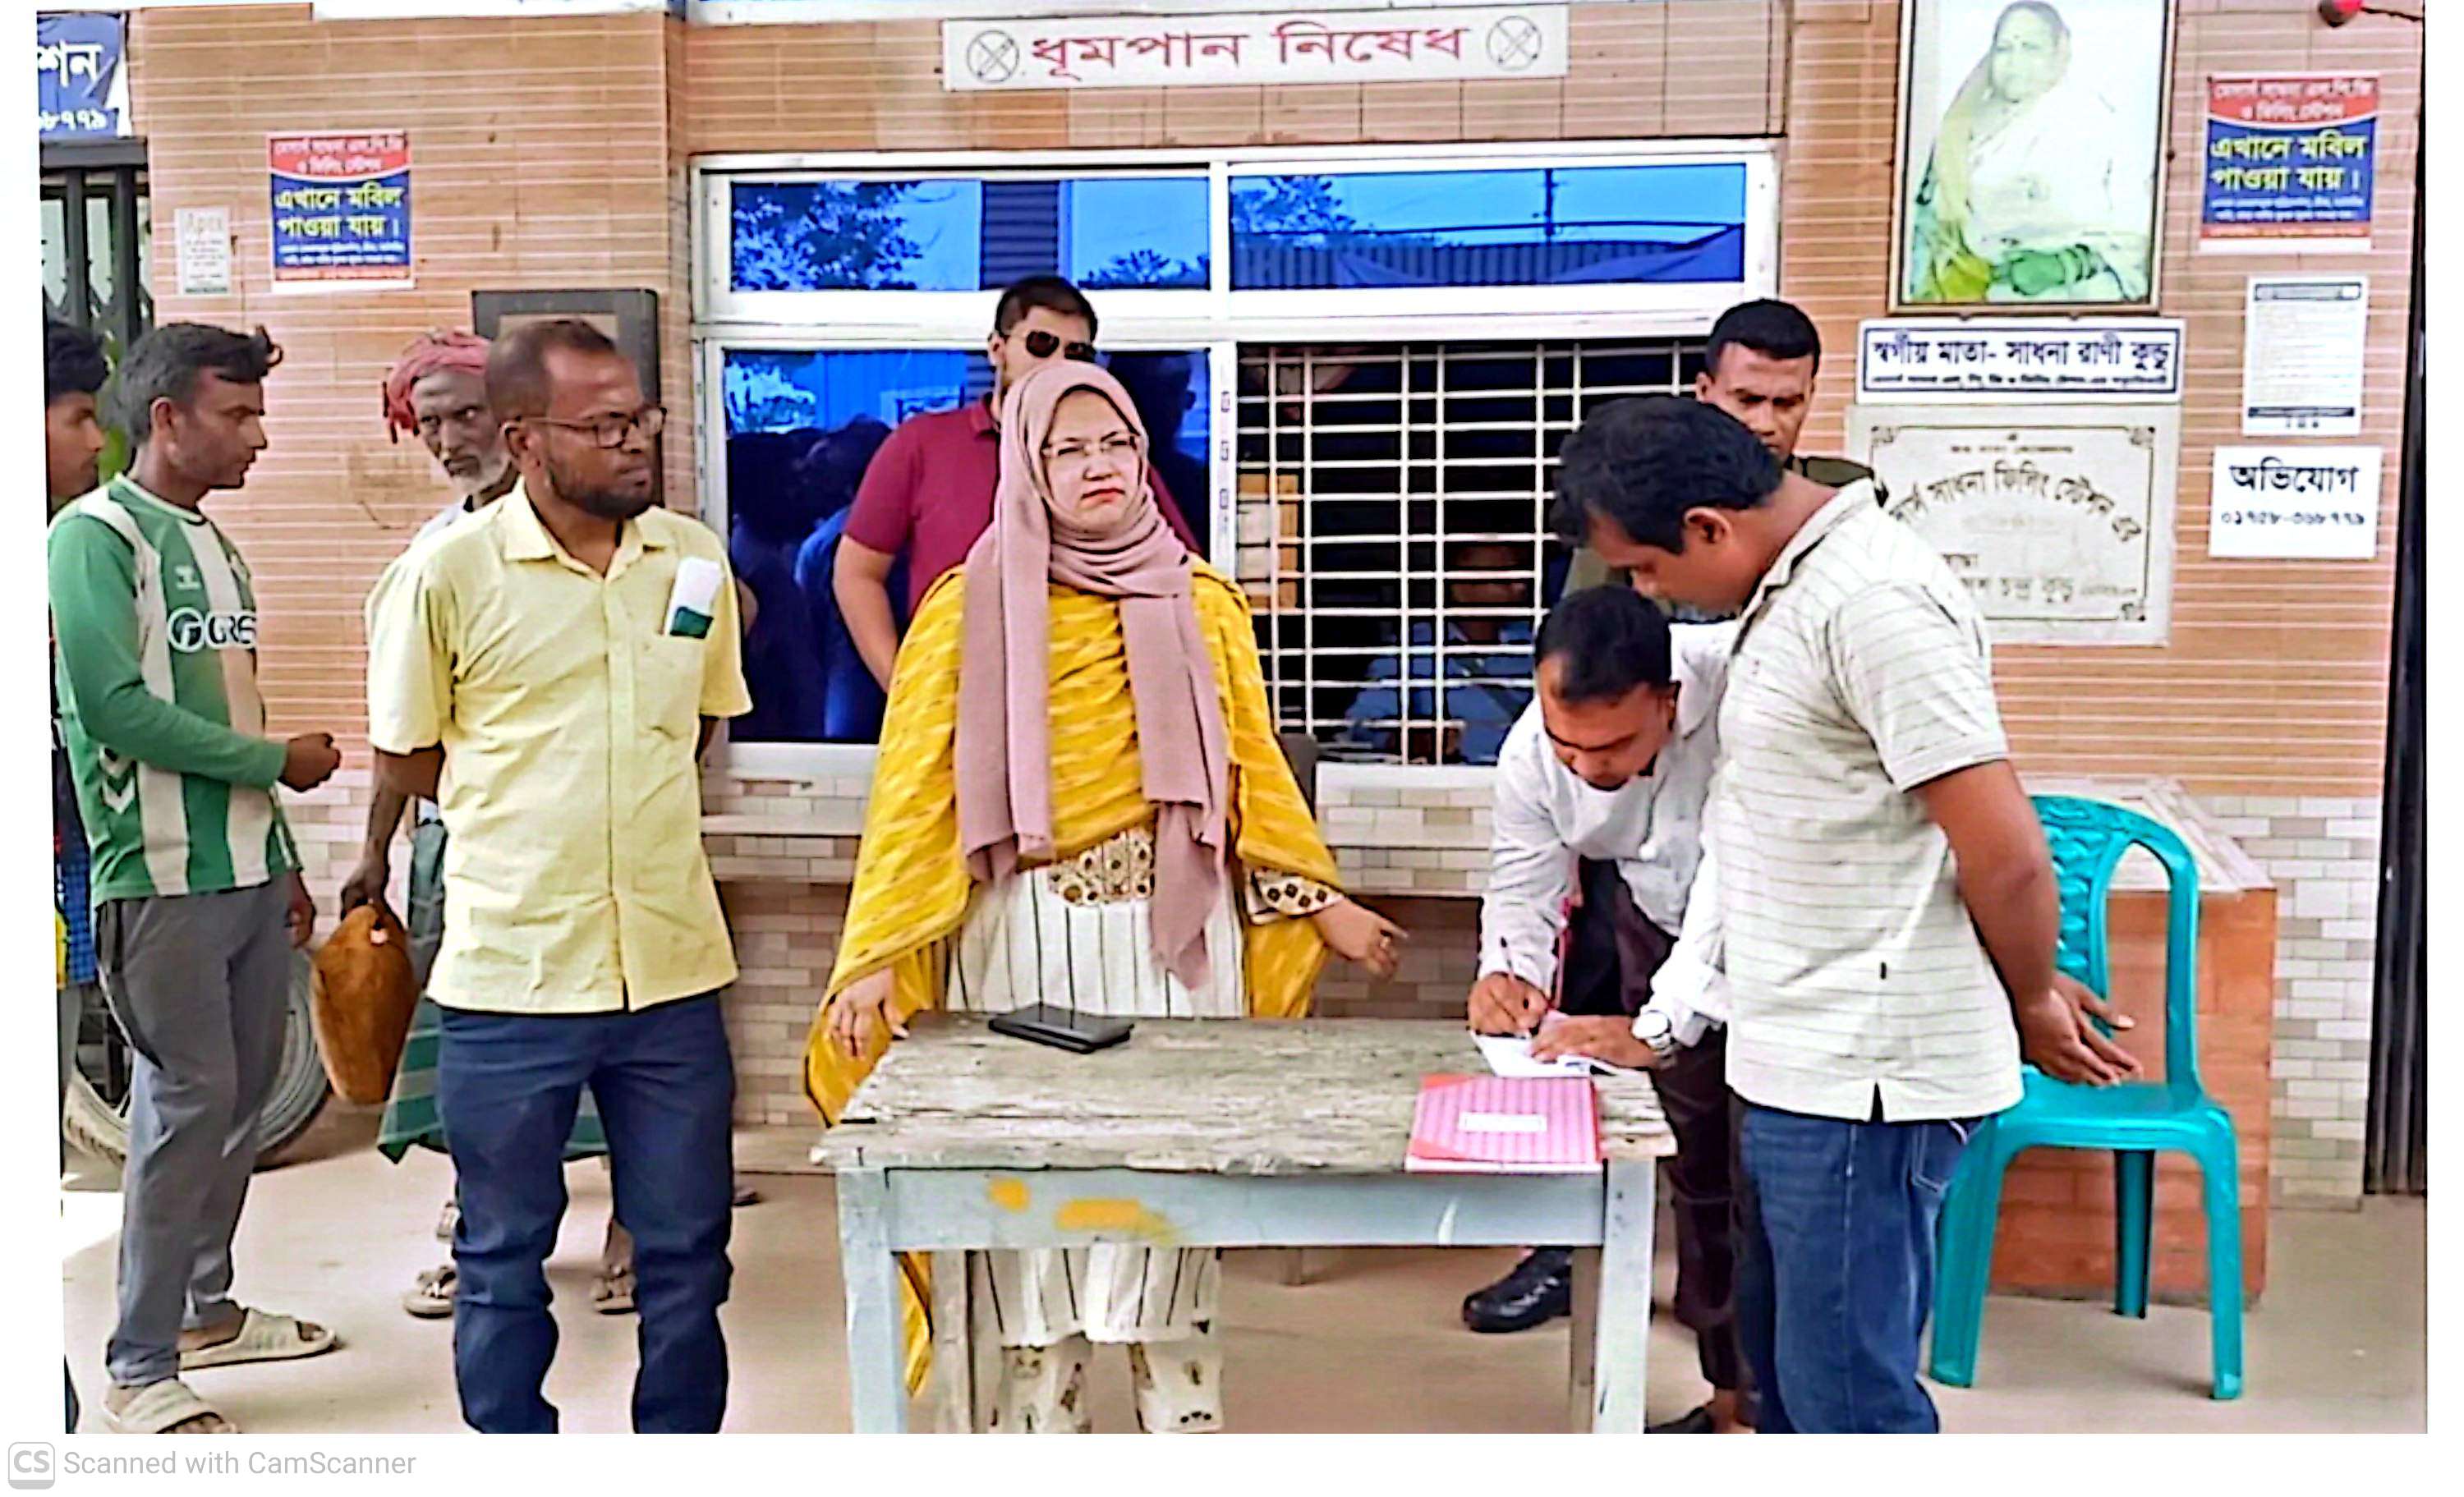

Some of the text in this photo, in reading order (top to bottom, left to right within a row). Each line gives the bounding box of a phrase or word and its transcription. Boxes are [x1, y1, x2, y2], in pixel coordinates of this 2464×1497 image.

[1031, 21, 1473, 80] ধূমপান নিষেধ
[2209, 129, 2368, 161] এখানে মবিল
[2209, 166, 2291, 191] পাওয়া
[274, 181, 406, 209] এখানে মবিল
[277, 214, 342, 238] পাওয়া
[2005, 340, 2071, 365] সাধনা
[2228, 457, 2361, 494] অভিযোগ
